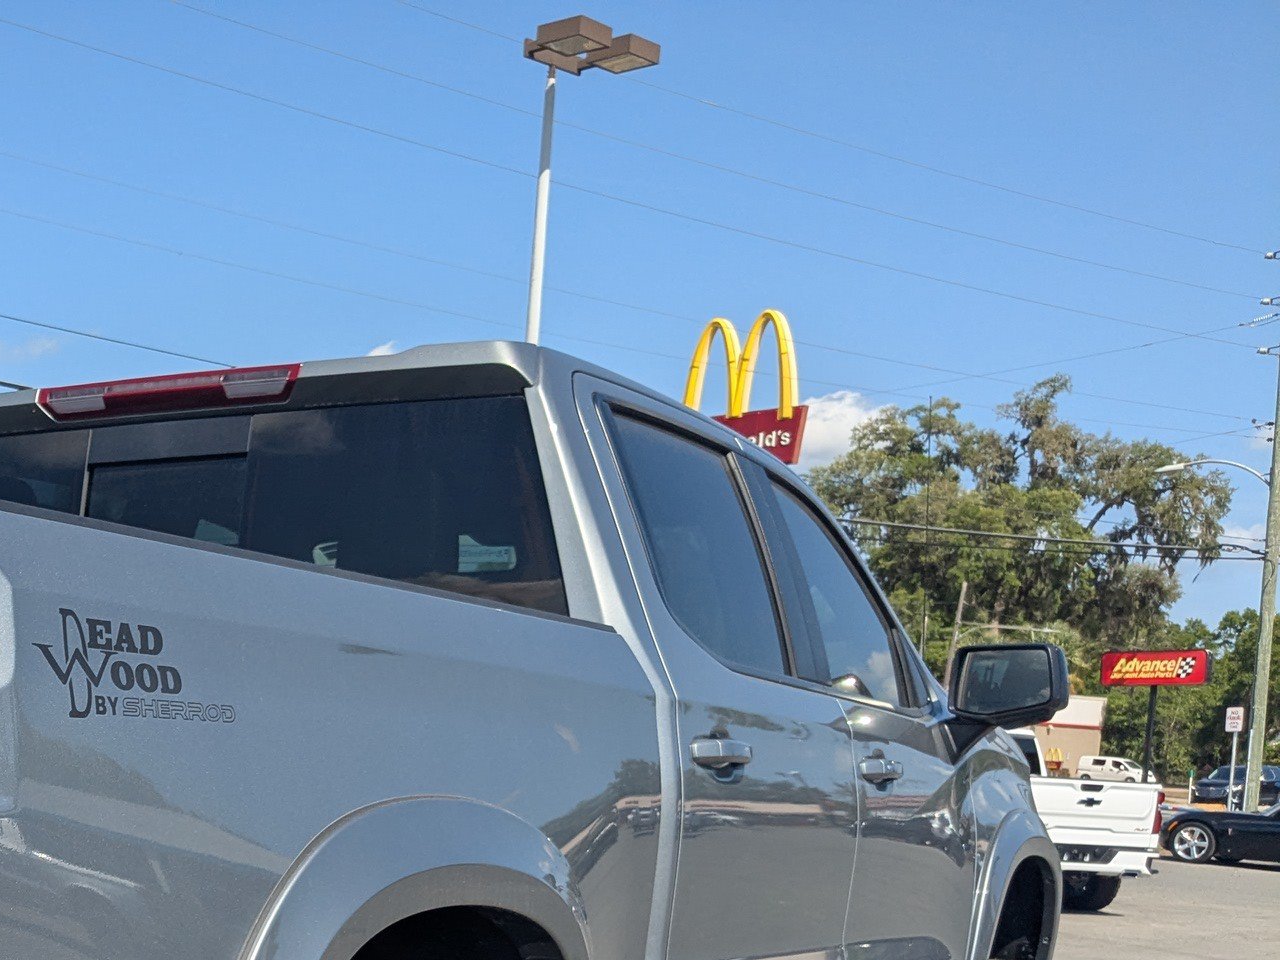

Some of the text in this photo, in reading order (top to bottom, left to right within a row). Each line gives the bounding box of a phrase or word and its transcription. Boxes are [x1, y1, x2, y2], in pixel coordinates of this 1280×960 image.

[31, 643, 182, 694] WOOD
[1113, 657, 1176, 673] Advance
[95, 695, 236, 724] BY SHERROD
